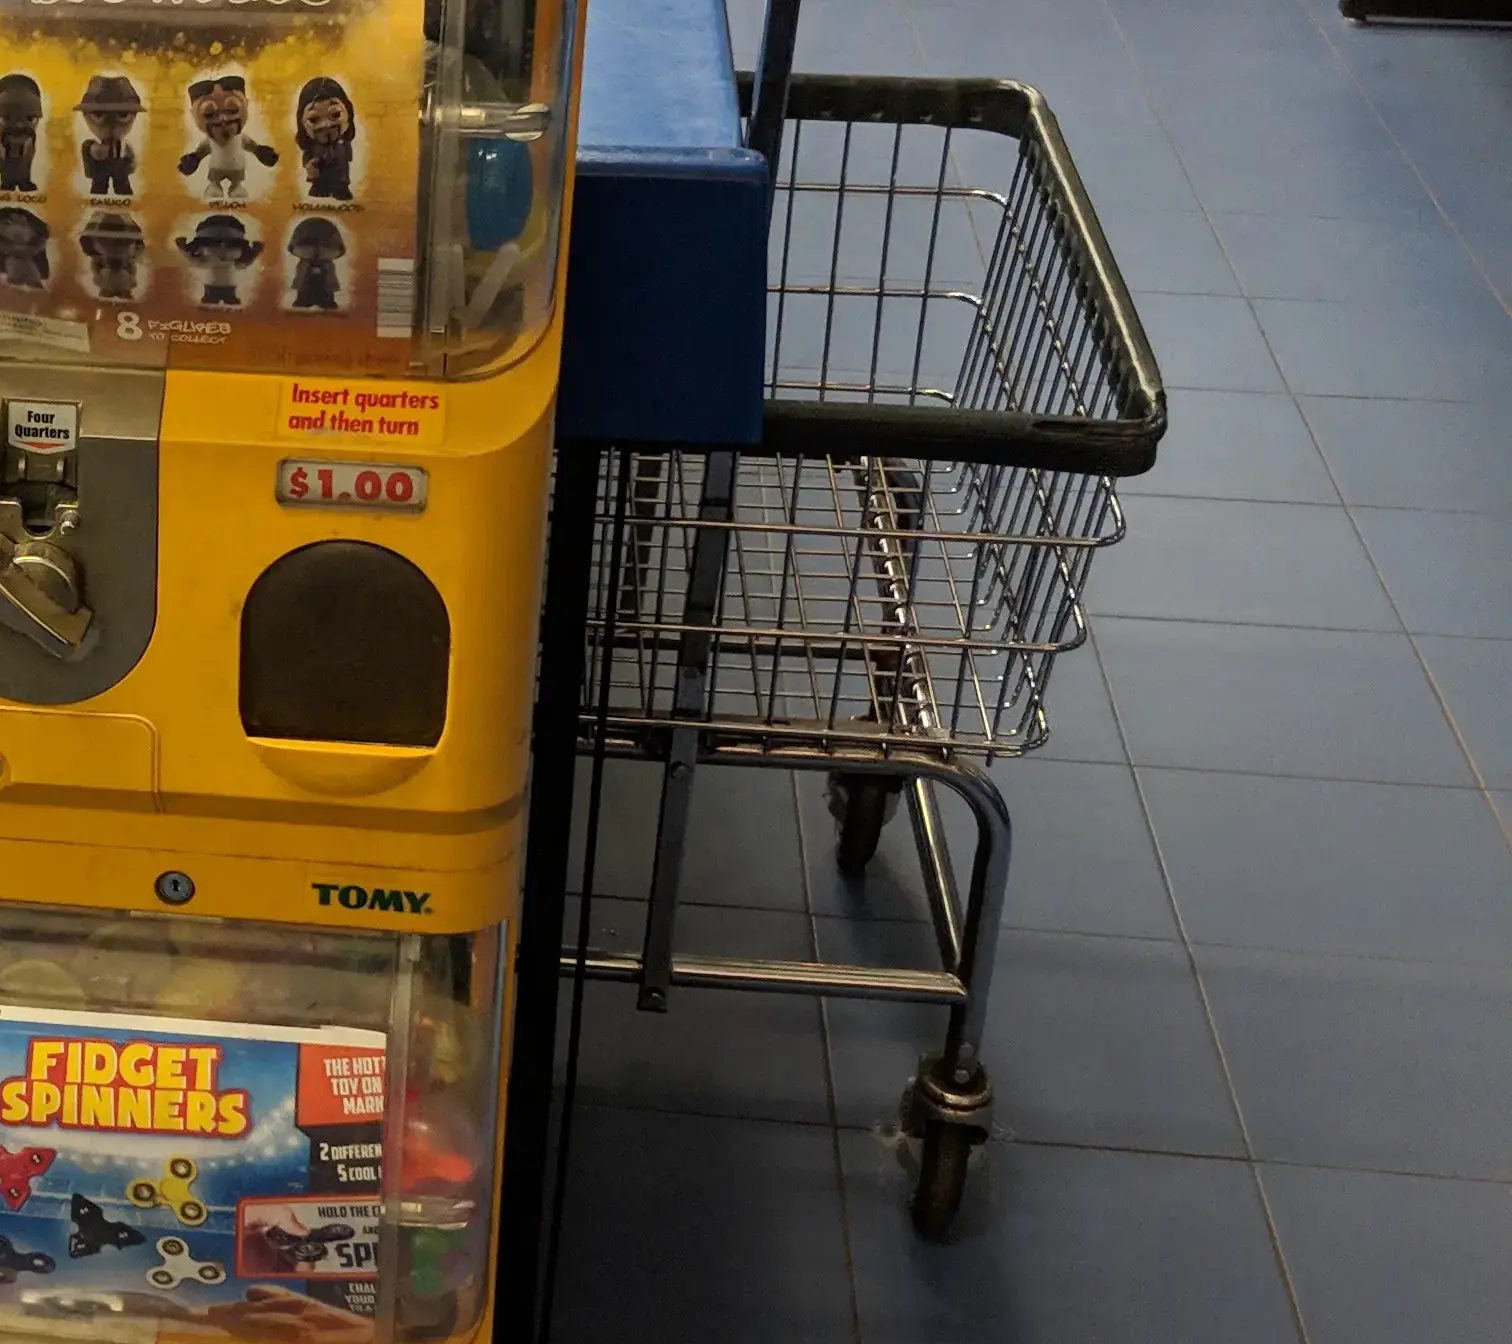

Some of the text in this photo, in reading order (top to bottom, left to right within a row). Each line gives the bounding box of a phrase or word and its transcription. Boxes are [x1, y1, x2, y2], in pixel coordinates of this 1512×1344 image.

[116, 311, 143, 340] 8
[292, 383, 440, 413] Insert quarters
[27, 411, 55, 425] Four
[288, 410, 419, 436] and then turn
[14, 424, 70, 440] Quarters
[289, 467, 414, 502] $1.00
[29, 1040, 219, 1092] FIDGET
[323, 1057, 351, 1076] THE
[330, 1076, 382, 1096] TOY ON
[0, 1079, 249, 1136] SPINNERS
[319, 1142, 330, 1162] 2
[337, 1164, 375, 1183] 5 COOL
[318, 1206, 347, 1218] HOLD
[350, 1205, 369, 1217] THE
